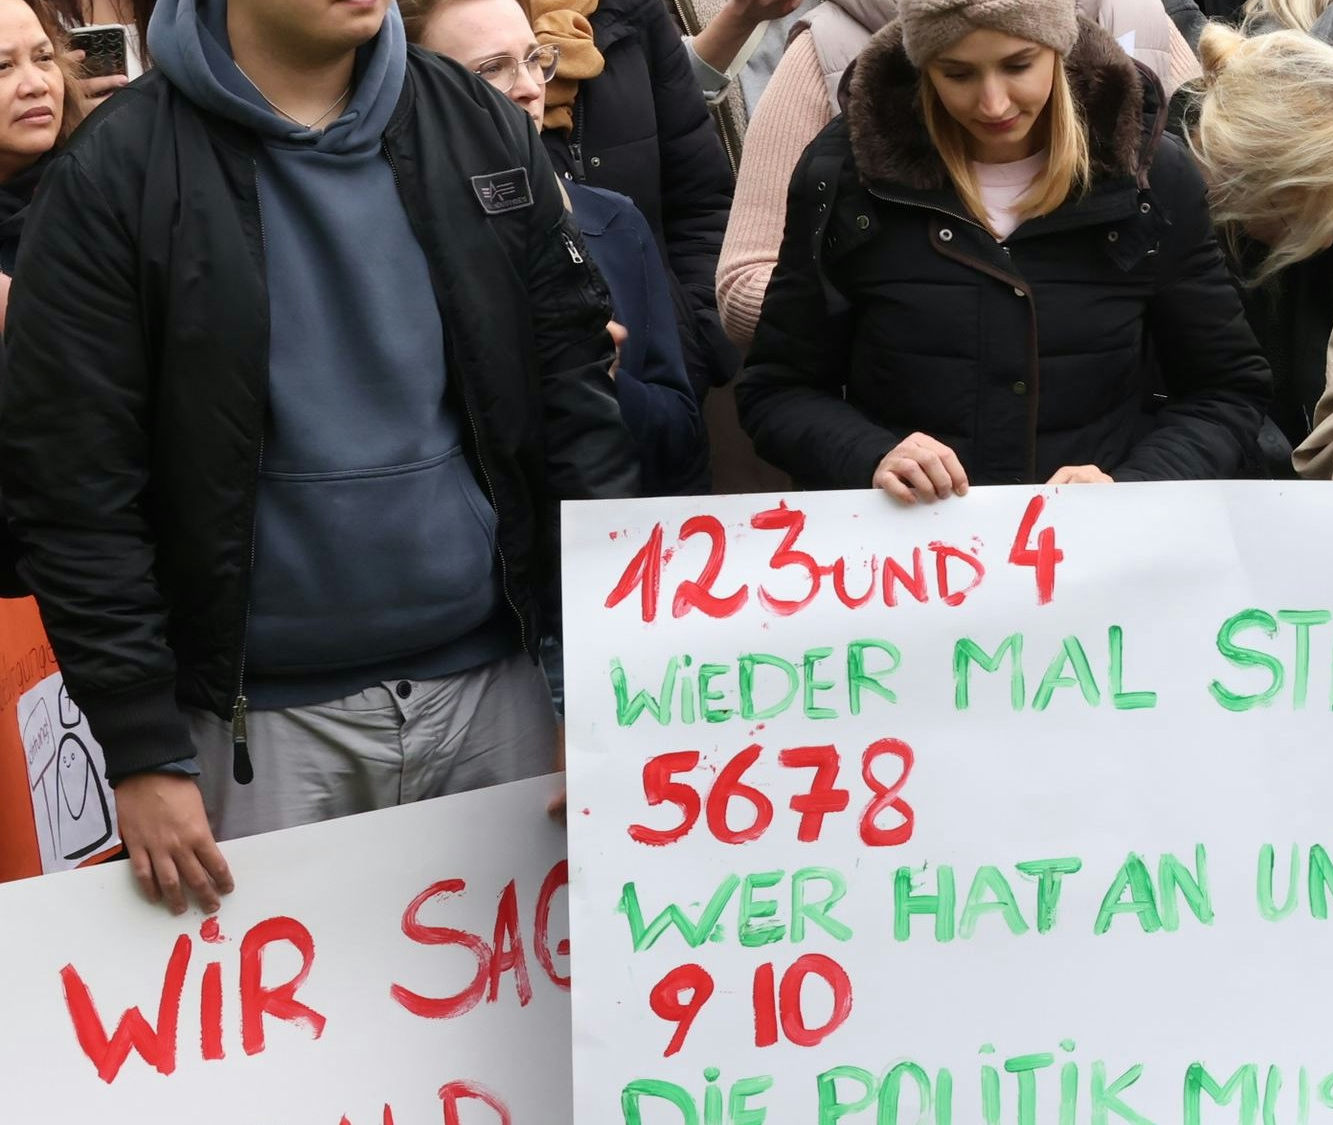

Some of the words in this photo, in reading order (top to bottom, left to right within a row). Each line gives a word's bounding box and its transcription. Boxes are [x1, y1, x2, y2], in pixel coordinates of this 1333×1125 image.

[1007, 494, 1065, 606] 4
[953, 625, 1158, 713] MAL
[616, 867, 854, 953] WER
[893, 857, 1082, 944] HAT
[1093, 842, 1215, 936] AN
[649, 962, 716, 1058] 9
[751, 952, 854, 1049] 10
